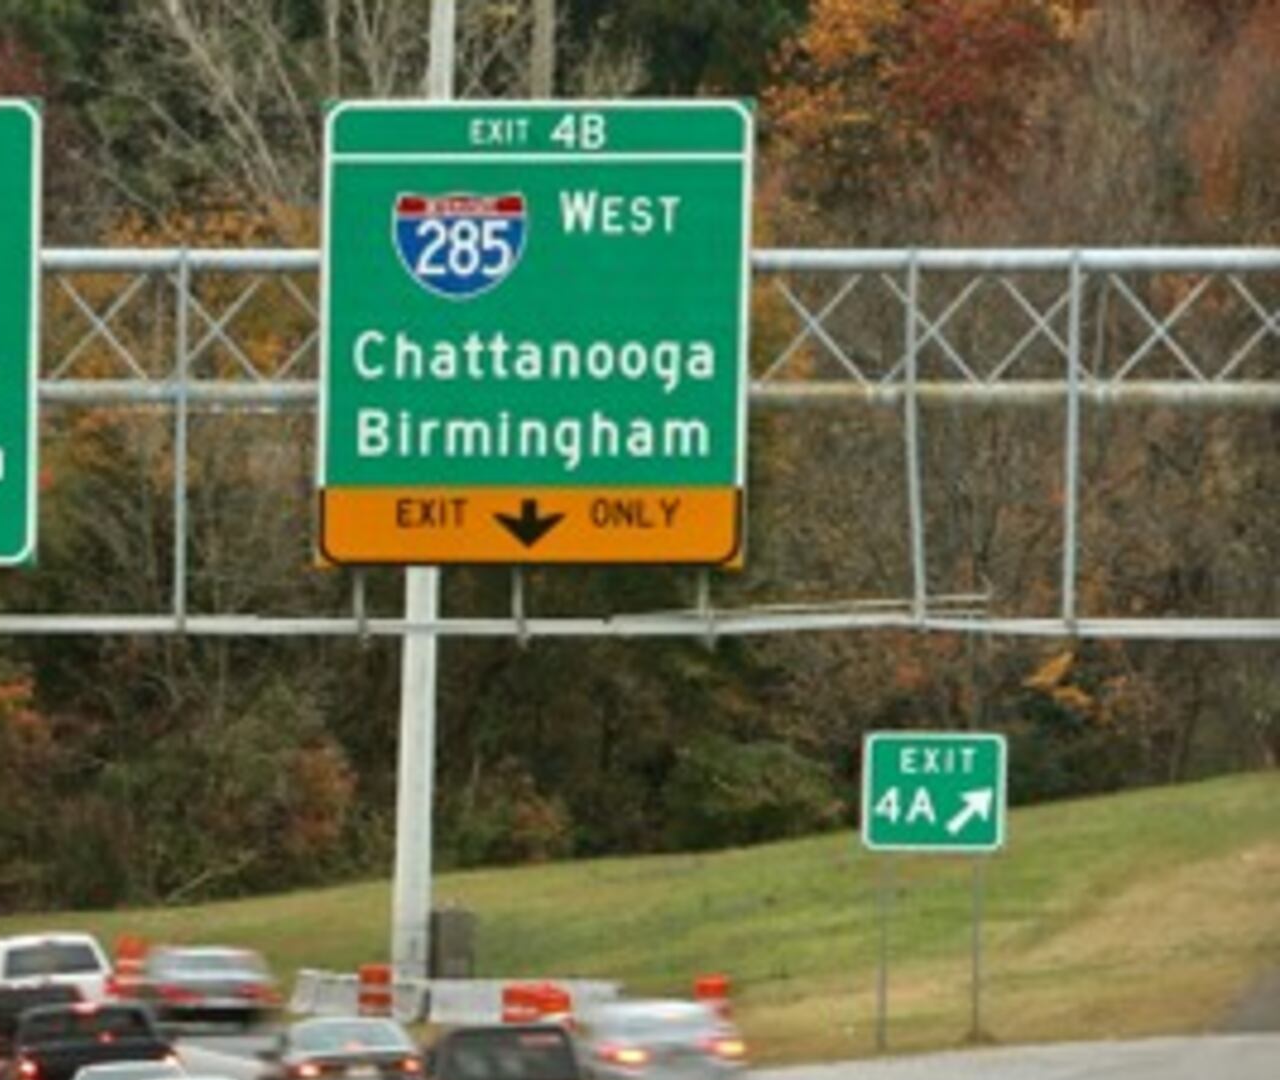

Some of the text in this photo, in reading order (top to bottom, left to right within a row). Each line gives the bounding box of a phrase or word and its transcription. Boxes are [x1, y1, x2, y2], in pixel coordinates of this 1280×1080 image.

[469, 113, 606, 150] EXIT 4B
[558, 190, 682, 234] WEST
[416, 218, 513, 276] 285
[352, 329, 716, 394] Chattanooga
[356, 408, 711, 471] Birmingham
[396, 498, 681, 529] EXIT ONLY
[899, 746, 978, 775] EXIT
[873, 785, 937, 825] 4A
